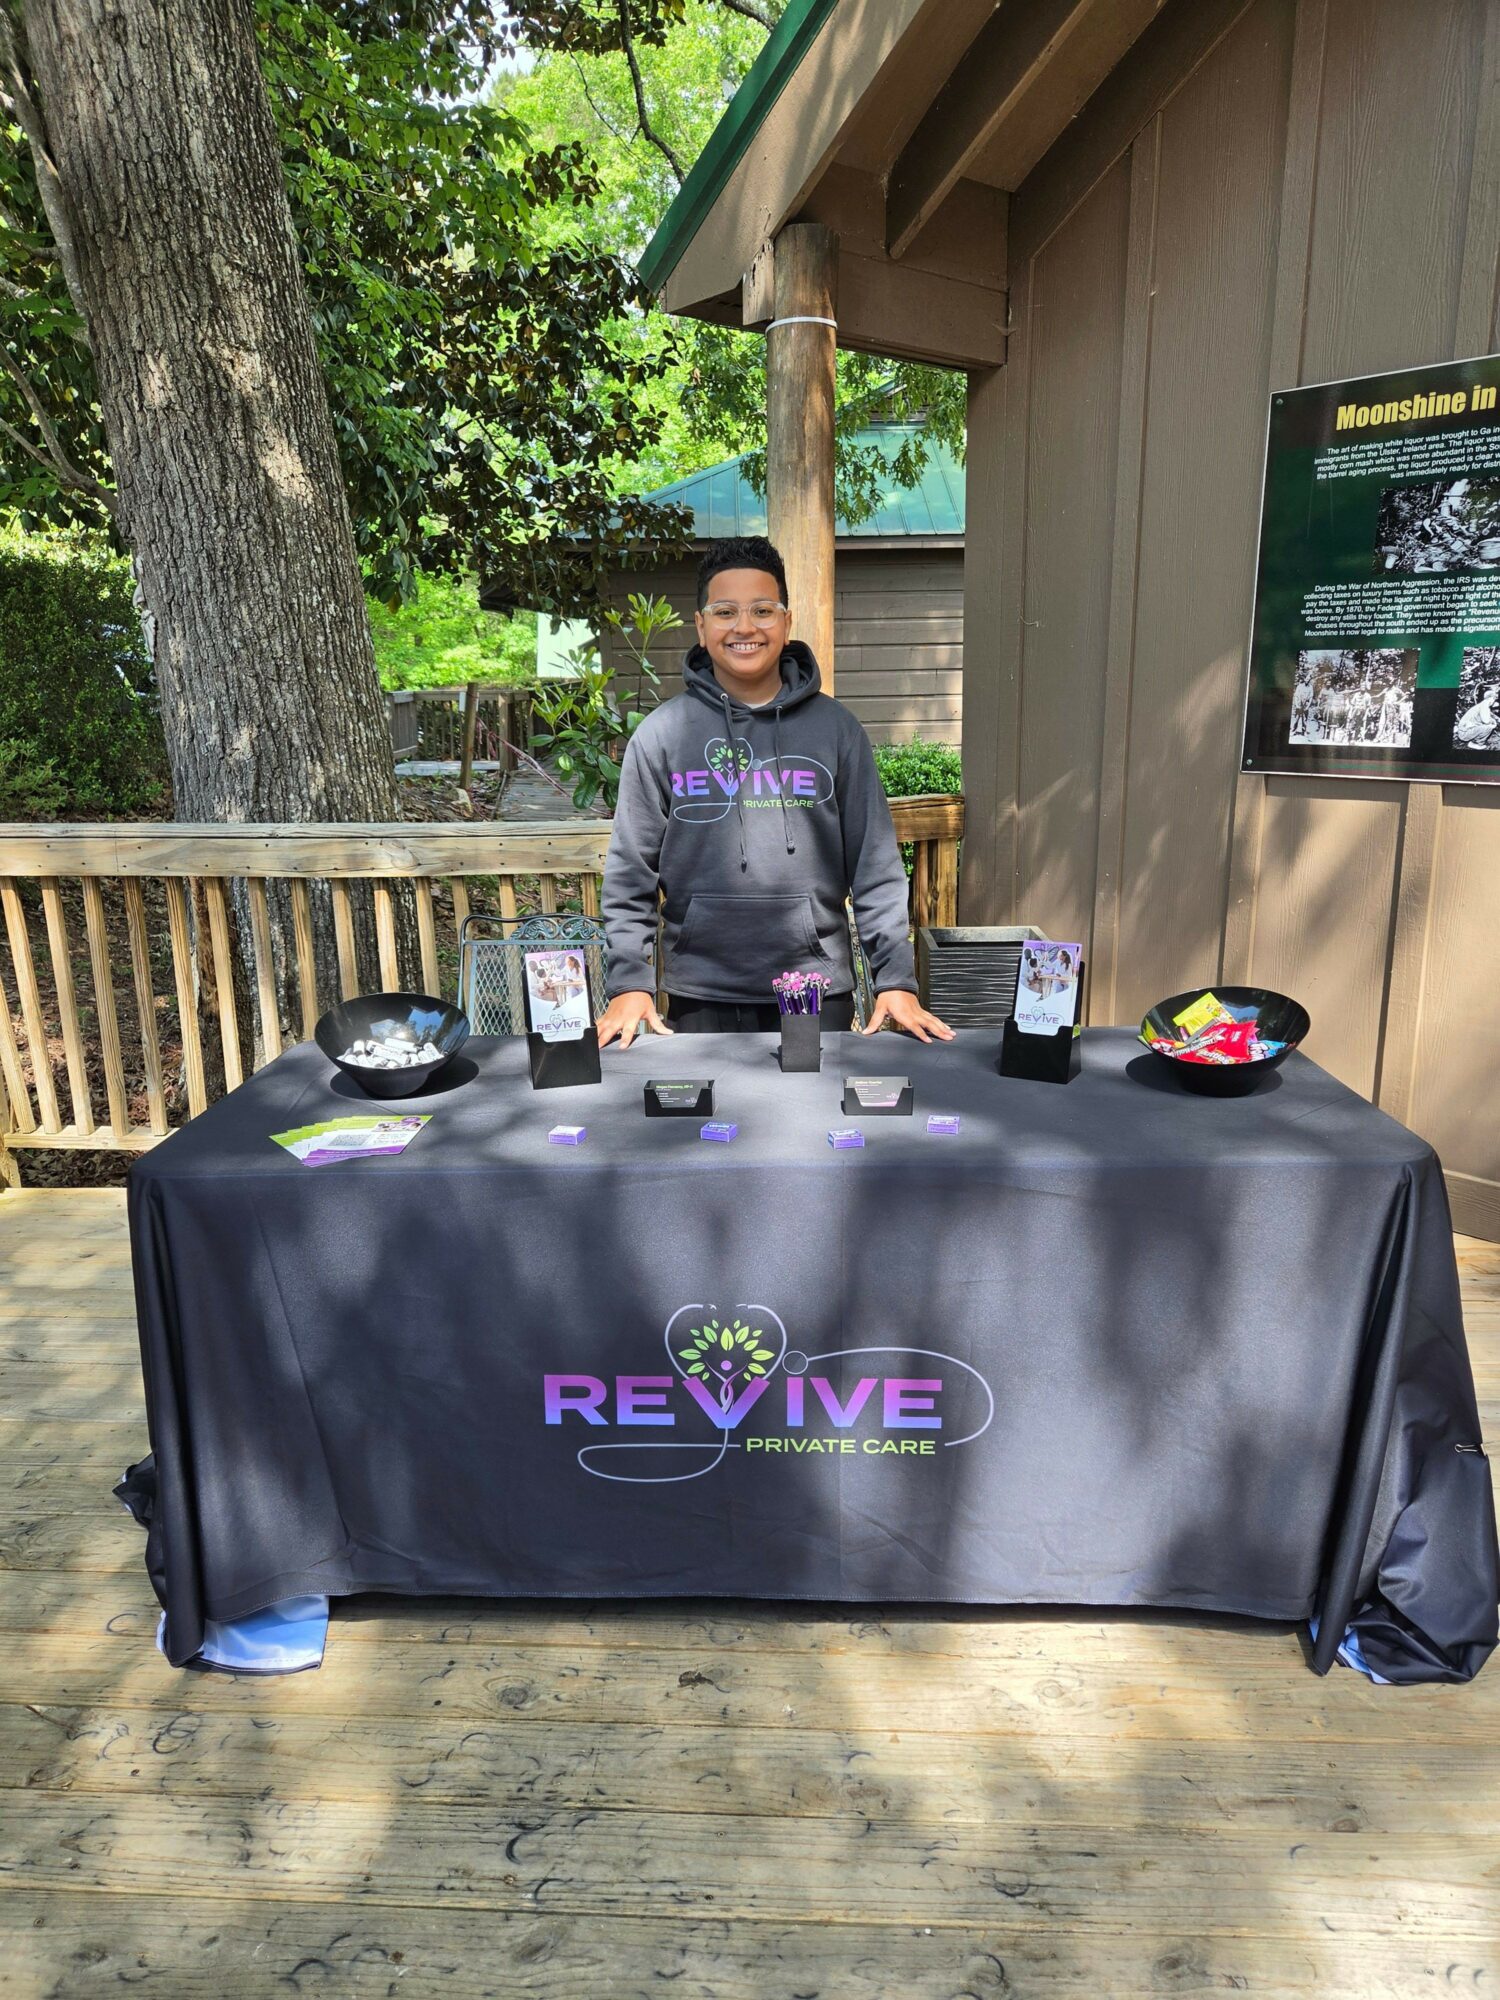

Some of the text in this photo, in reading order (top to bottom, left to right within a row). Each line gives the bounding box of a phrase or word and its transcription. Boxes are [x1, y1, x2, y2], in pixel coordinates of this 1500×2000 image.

[1336, 384, 1496, 430] Moonshine in
[1359, 442, 1383, 450] making
[1404, 437, 1424, 445] liquor
[1442, 430, 1469, 440] brought
[1402, 444, 1427, 452] Ireland
[1464, 437, 1484, 446] liquor
[1431, 447, 1465, 457] abundant
[1328, 470, 1348, 478] barrel
[1348, 468, 1366, 477] aging
[1368, 466, 1396, 475] process,
[1410, 460, 1430, 468] liquor
[1432, 455, 1466, 467] produced
[1406, 466, 1448, 477] immediately
[1450, 464, 1470, 472] ready
[1401, 579, 1441, 588] Aggression,
[1394, 596, 1414, 604] liquor
[1422, 594, 1440, 602] night
[1465, 592, 1481, 601] light
[1336, 606, 1344, 614] By
[1377, 604, 1402, 612] Federal
[1404, 602, 1445, 612] government
[1446, 602, 1469, 610] began
[1479, 600, 1498, 608] seek
[1339, 620, 1373, 628] throughout
[1361, 628, 1377, 636] legal
[671, 770, 816, 797] REVIVE
[785, 799, 814, 808] CARE
[1018, 1013, 1060, 1024] REVIVE
[536, 1020, 581, 1032] REVIVE
[544, 1374, 942, 1430] REVIVE
[746, 1438, 936, 1454] PRIVATE CARE
